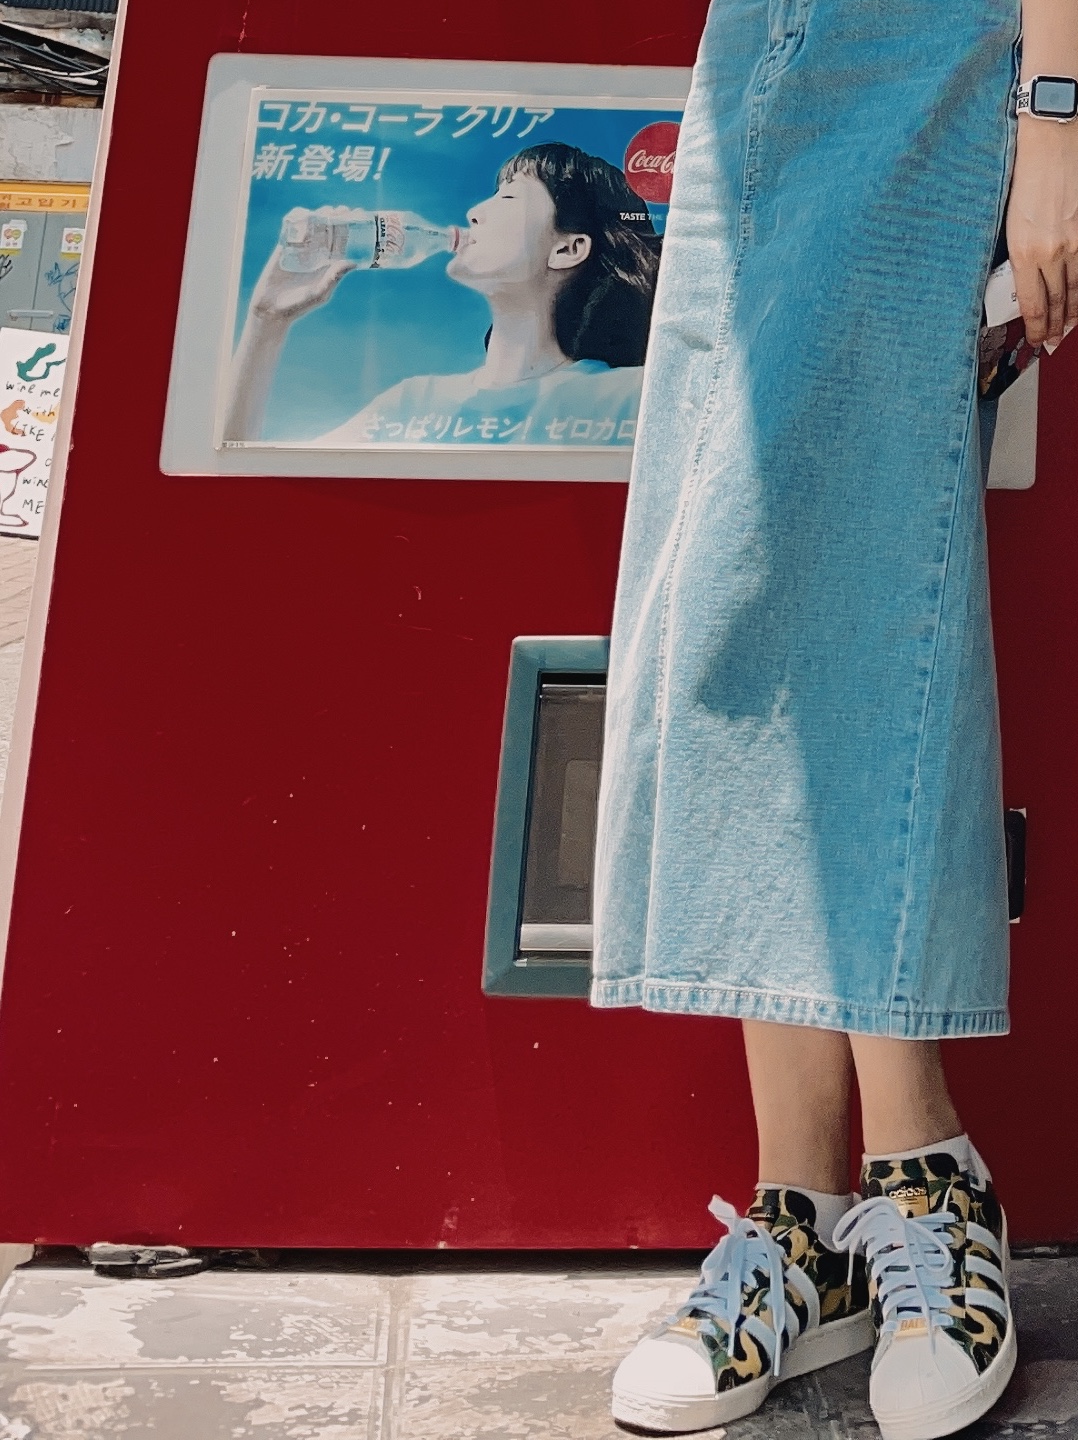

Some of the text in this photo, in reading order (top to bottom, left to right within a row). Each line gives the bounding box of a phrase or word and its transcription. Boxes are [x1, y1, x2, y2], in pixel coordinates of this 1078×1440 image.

[256, 101, 555, 139] コカ・コーラ クリア
[252, 143, 392, 182] 新登場!
[619, 212, 646, 221] TASTE
[40, 388, 60, 398] me
[11, 420, 45, 442] LIKE
[22, 498, 44, 515] ME
[888, 1185, 928, 1200] adidas
